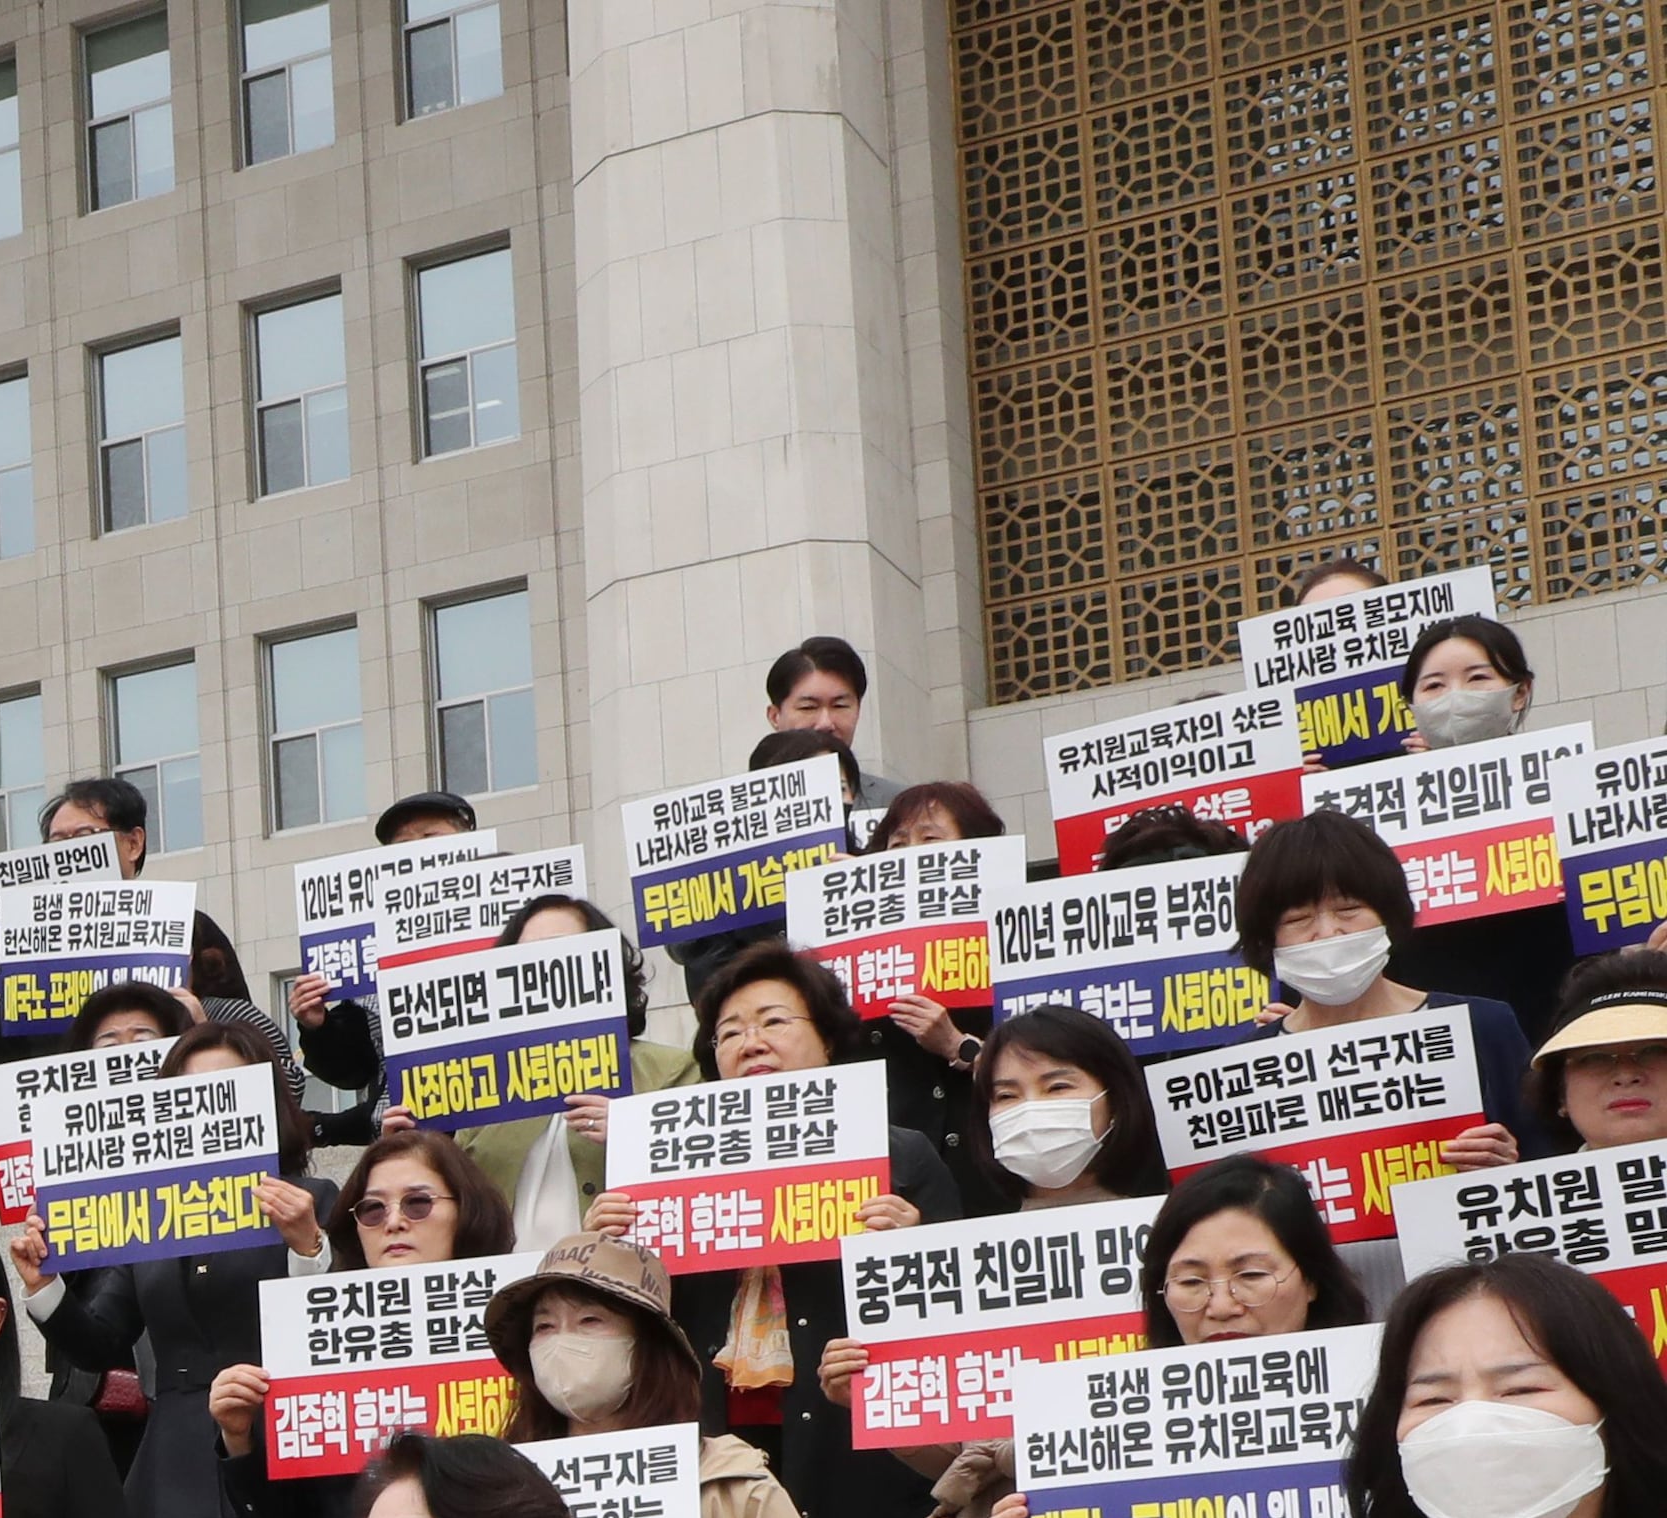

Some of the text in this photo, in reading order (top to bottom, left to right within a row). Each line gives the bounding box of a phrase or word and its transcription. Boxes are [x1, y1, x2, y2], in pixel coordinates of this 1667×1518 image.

[1272, 582, 1455, 650] 유아교육 불모지에
[1091, 739, 1255, 799] 사적이익이고
[1416, 764, 1513, 825] 친일파
[635, 796, 833, 868] 나라사랑 유치원 설립자
[652, 770, 807, 832] 유아교육 불모지에
[32, 889, 153, 922] 평생 유아교육에
[823, 848, 981, 903] 유치원 말살
[3, 920, 186, 956] 헌신해온 유치원교육자를
[824, 884, 982, 938] 한유총 말살
[995, 886, 1158, 965] 120년 유아교육
[388, 948, 613, 1039] 당선되면 그만이냐!
[400, 1031, 621, 1118] 사죄하고 사퇴하라!
[1165, 1022, 1456, 1116] 유아교육의 선구자를
[64, 1079, 238, 1138] 유아교육 불모지에
[648, 1078, 839, 1134] 유치원 말살
[1186, 1074, 1448, 1152] 친일파로 매도하는
[43, 1114, 265, 1177] 나라사랑 유치원 설립자
[649, 1118, 839, 1175] 한유총 말살
[1456, 1166, 1603, 1230] 유치원
[305, 1268, 498, 1325] 유치원 말살
[854, 1232, 1086, 1326] 충격적 친일파
[861, 1353, 950, 1432] 김준혁
[1086, 1346, 1331, 1421] 평생 유아교육에
[1025, 1422, 1156, 1479] 헌신해온
